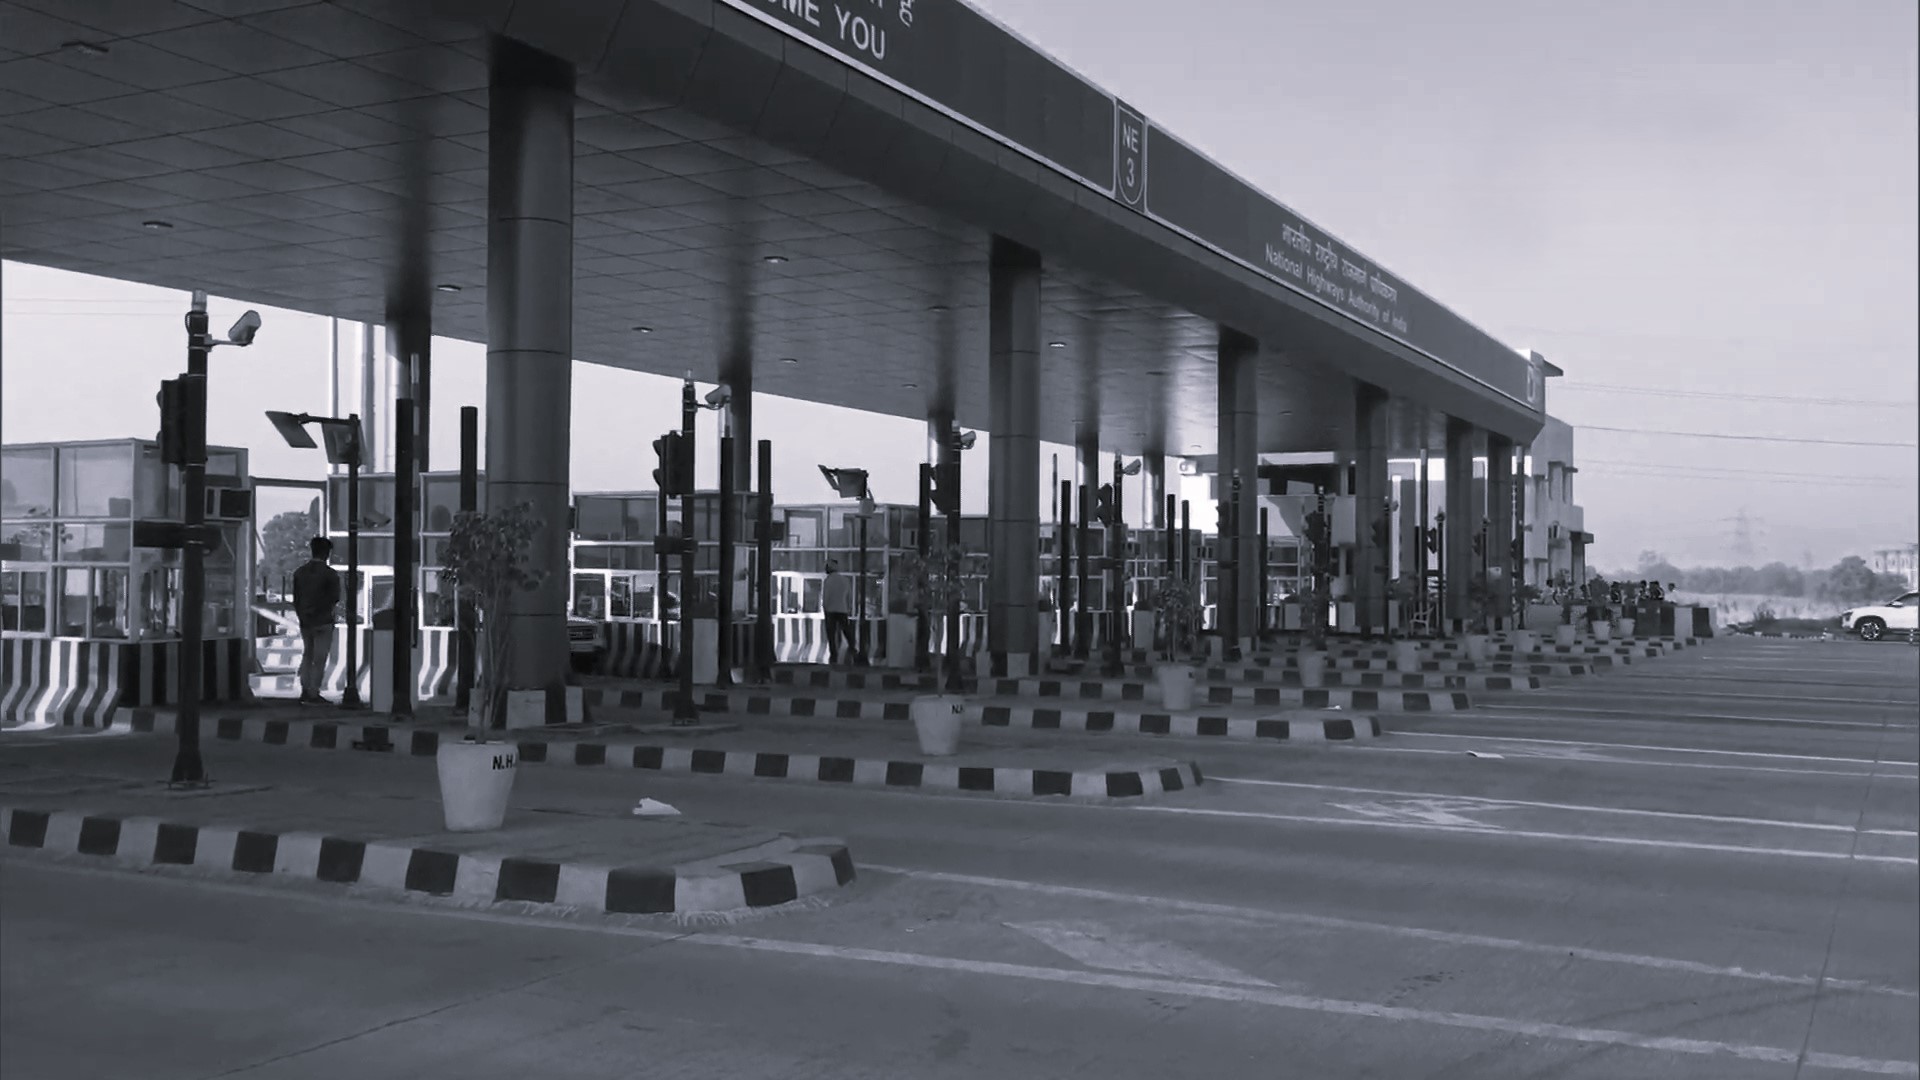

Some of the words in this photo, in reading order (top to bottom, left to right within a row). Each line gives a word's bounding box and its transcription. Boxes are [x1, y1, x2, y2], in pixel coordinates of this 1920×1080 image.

[834, 3, 885, 61] YOU
[1122, 122, 1139, 153] NE
[1126, 157, 1134, 188] 3
[1265, 243, 1303, 279] National
[1306, 264, 1344, 303] Highways
[1348, 288, 1379, 321] Authority
[1382, 309, 1390, 323] of
